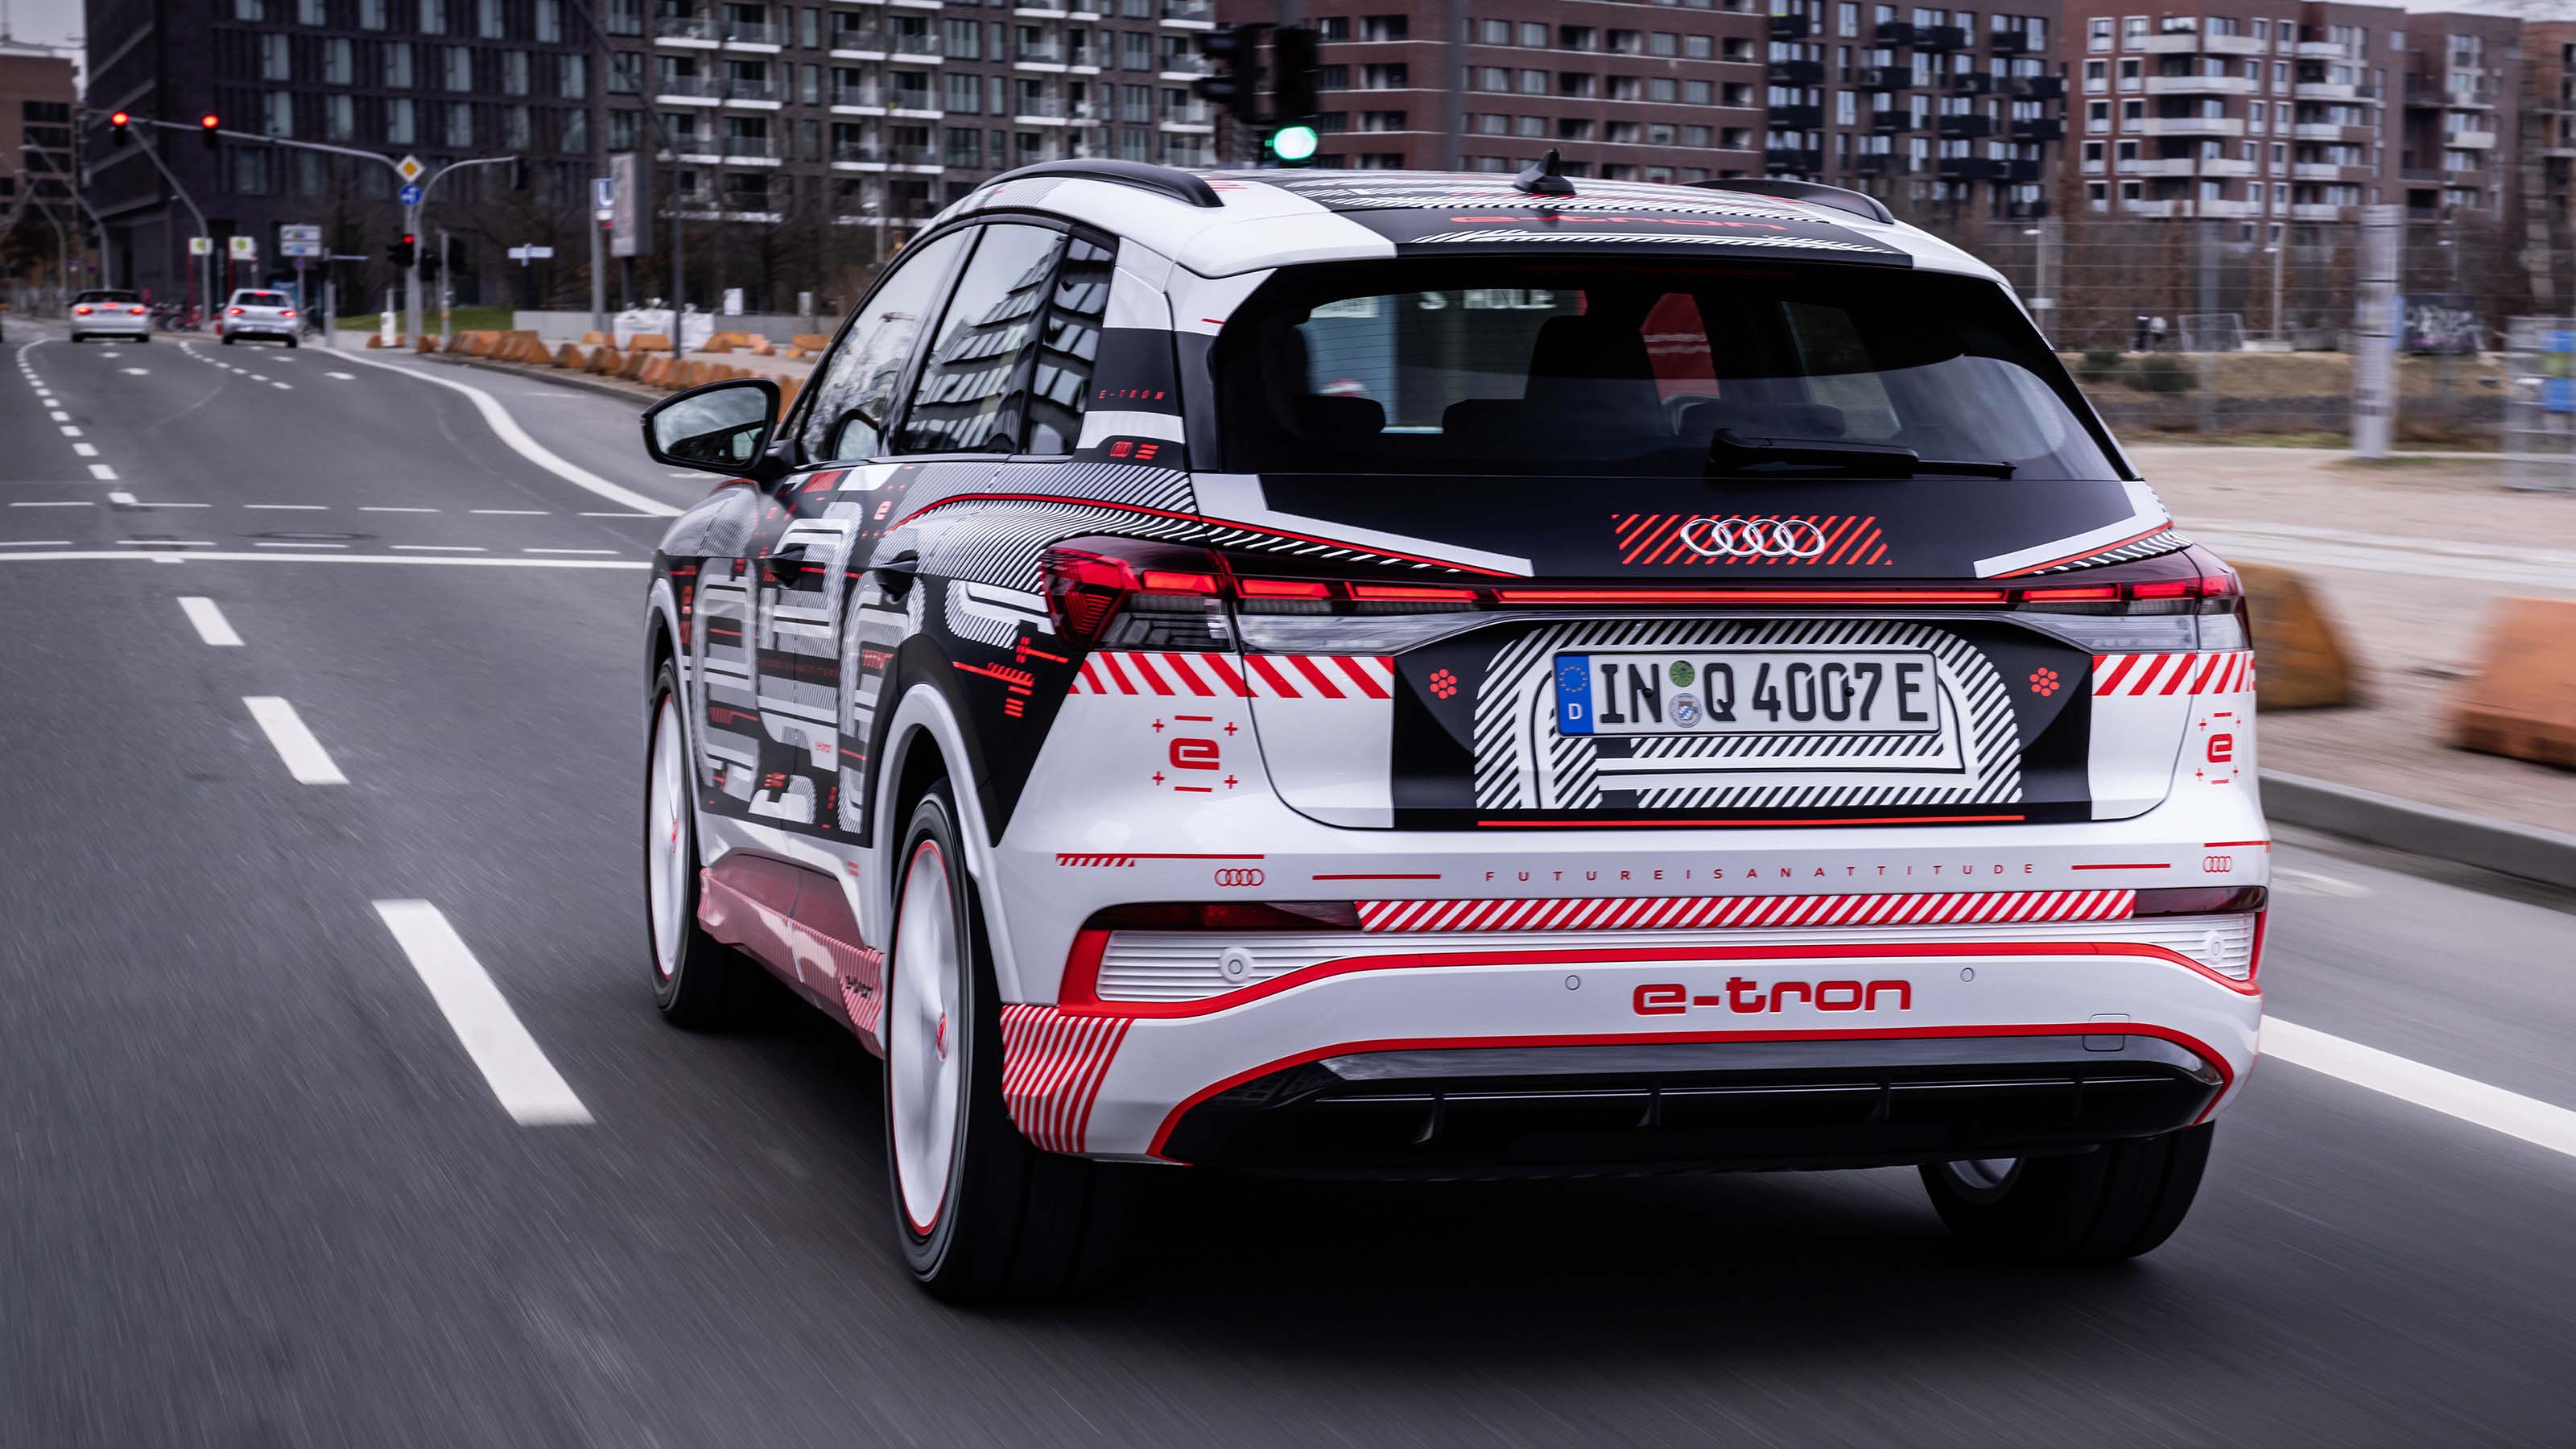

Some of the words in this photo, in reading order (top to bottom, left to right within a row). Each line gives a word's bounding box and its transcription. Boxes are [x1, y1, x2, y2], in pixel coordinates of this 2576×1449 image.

[1449, 214, 1790, 231] e-tron
[1098, 389, 1166, 400] E-TRON
[1600, 663, 1662, 723] IN
[1703, 663, 1736, 722] Q
[1568, 703, 1583, 720] D
[1169, 737, 1220, 770] e
[2207, 733, 2232, 763] e
[1633, 976, 1912, 1015] e-tron
